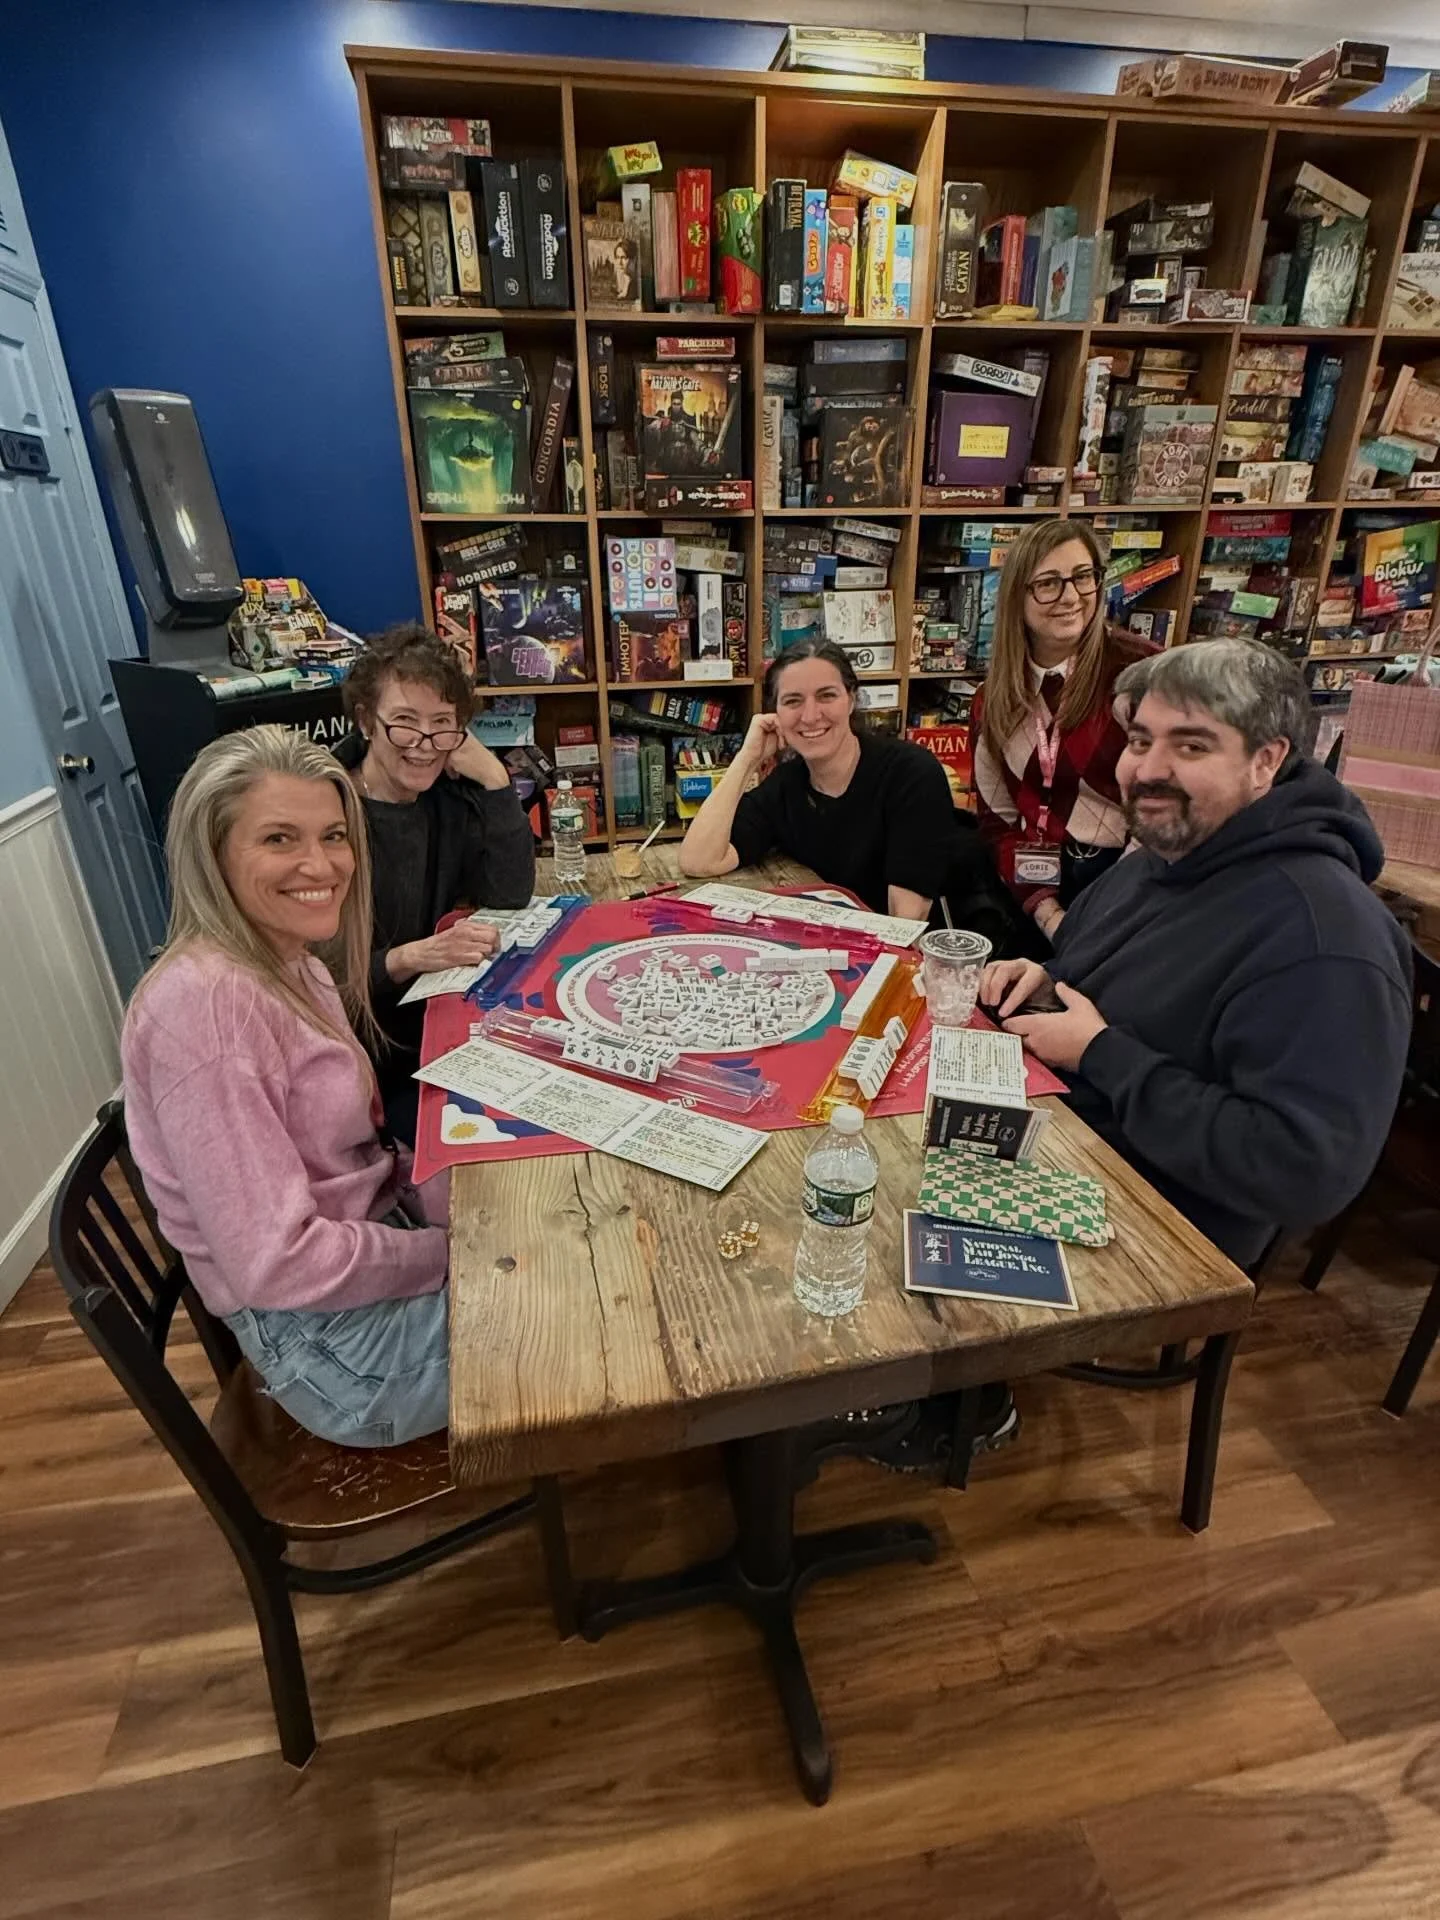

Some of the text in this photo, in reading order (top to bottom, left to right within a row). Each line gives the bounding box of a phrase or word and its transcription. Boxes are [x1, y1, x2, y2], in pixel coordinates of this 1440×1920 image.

[956, 251, 970, 293] CATAN
[678, 338, 725, 348] PARCHEESI
[973, 363, 1010, 383] SORRY!
[1227, 398, 1270, 416] Everdell
[535, 402, 561, 484] CONCORDIA
[1162, 445, 1189, 460] SHOP
[1155, 470, 1189, 487] DONUT
[456, 560, 517, 588] HORRIFIED
[627, 541, 643, 609] DONUTS
[1374, 562, 1424, 583] Blokus
[619, 620, 631, 676] IMHOTEP
[859, 653, 871, 664] K2
[962, 1237, 1022, 1253] NATIONAL
[963, 1245, 1037, 1263] MAH JONGG
[1020, 1258, 1051, 1275] INC.
